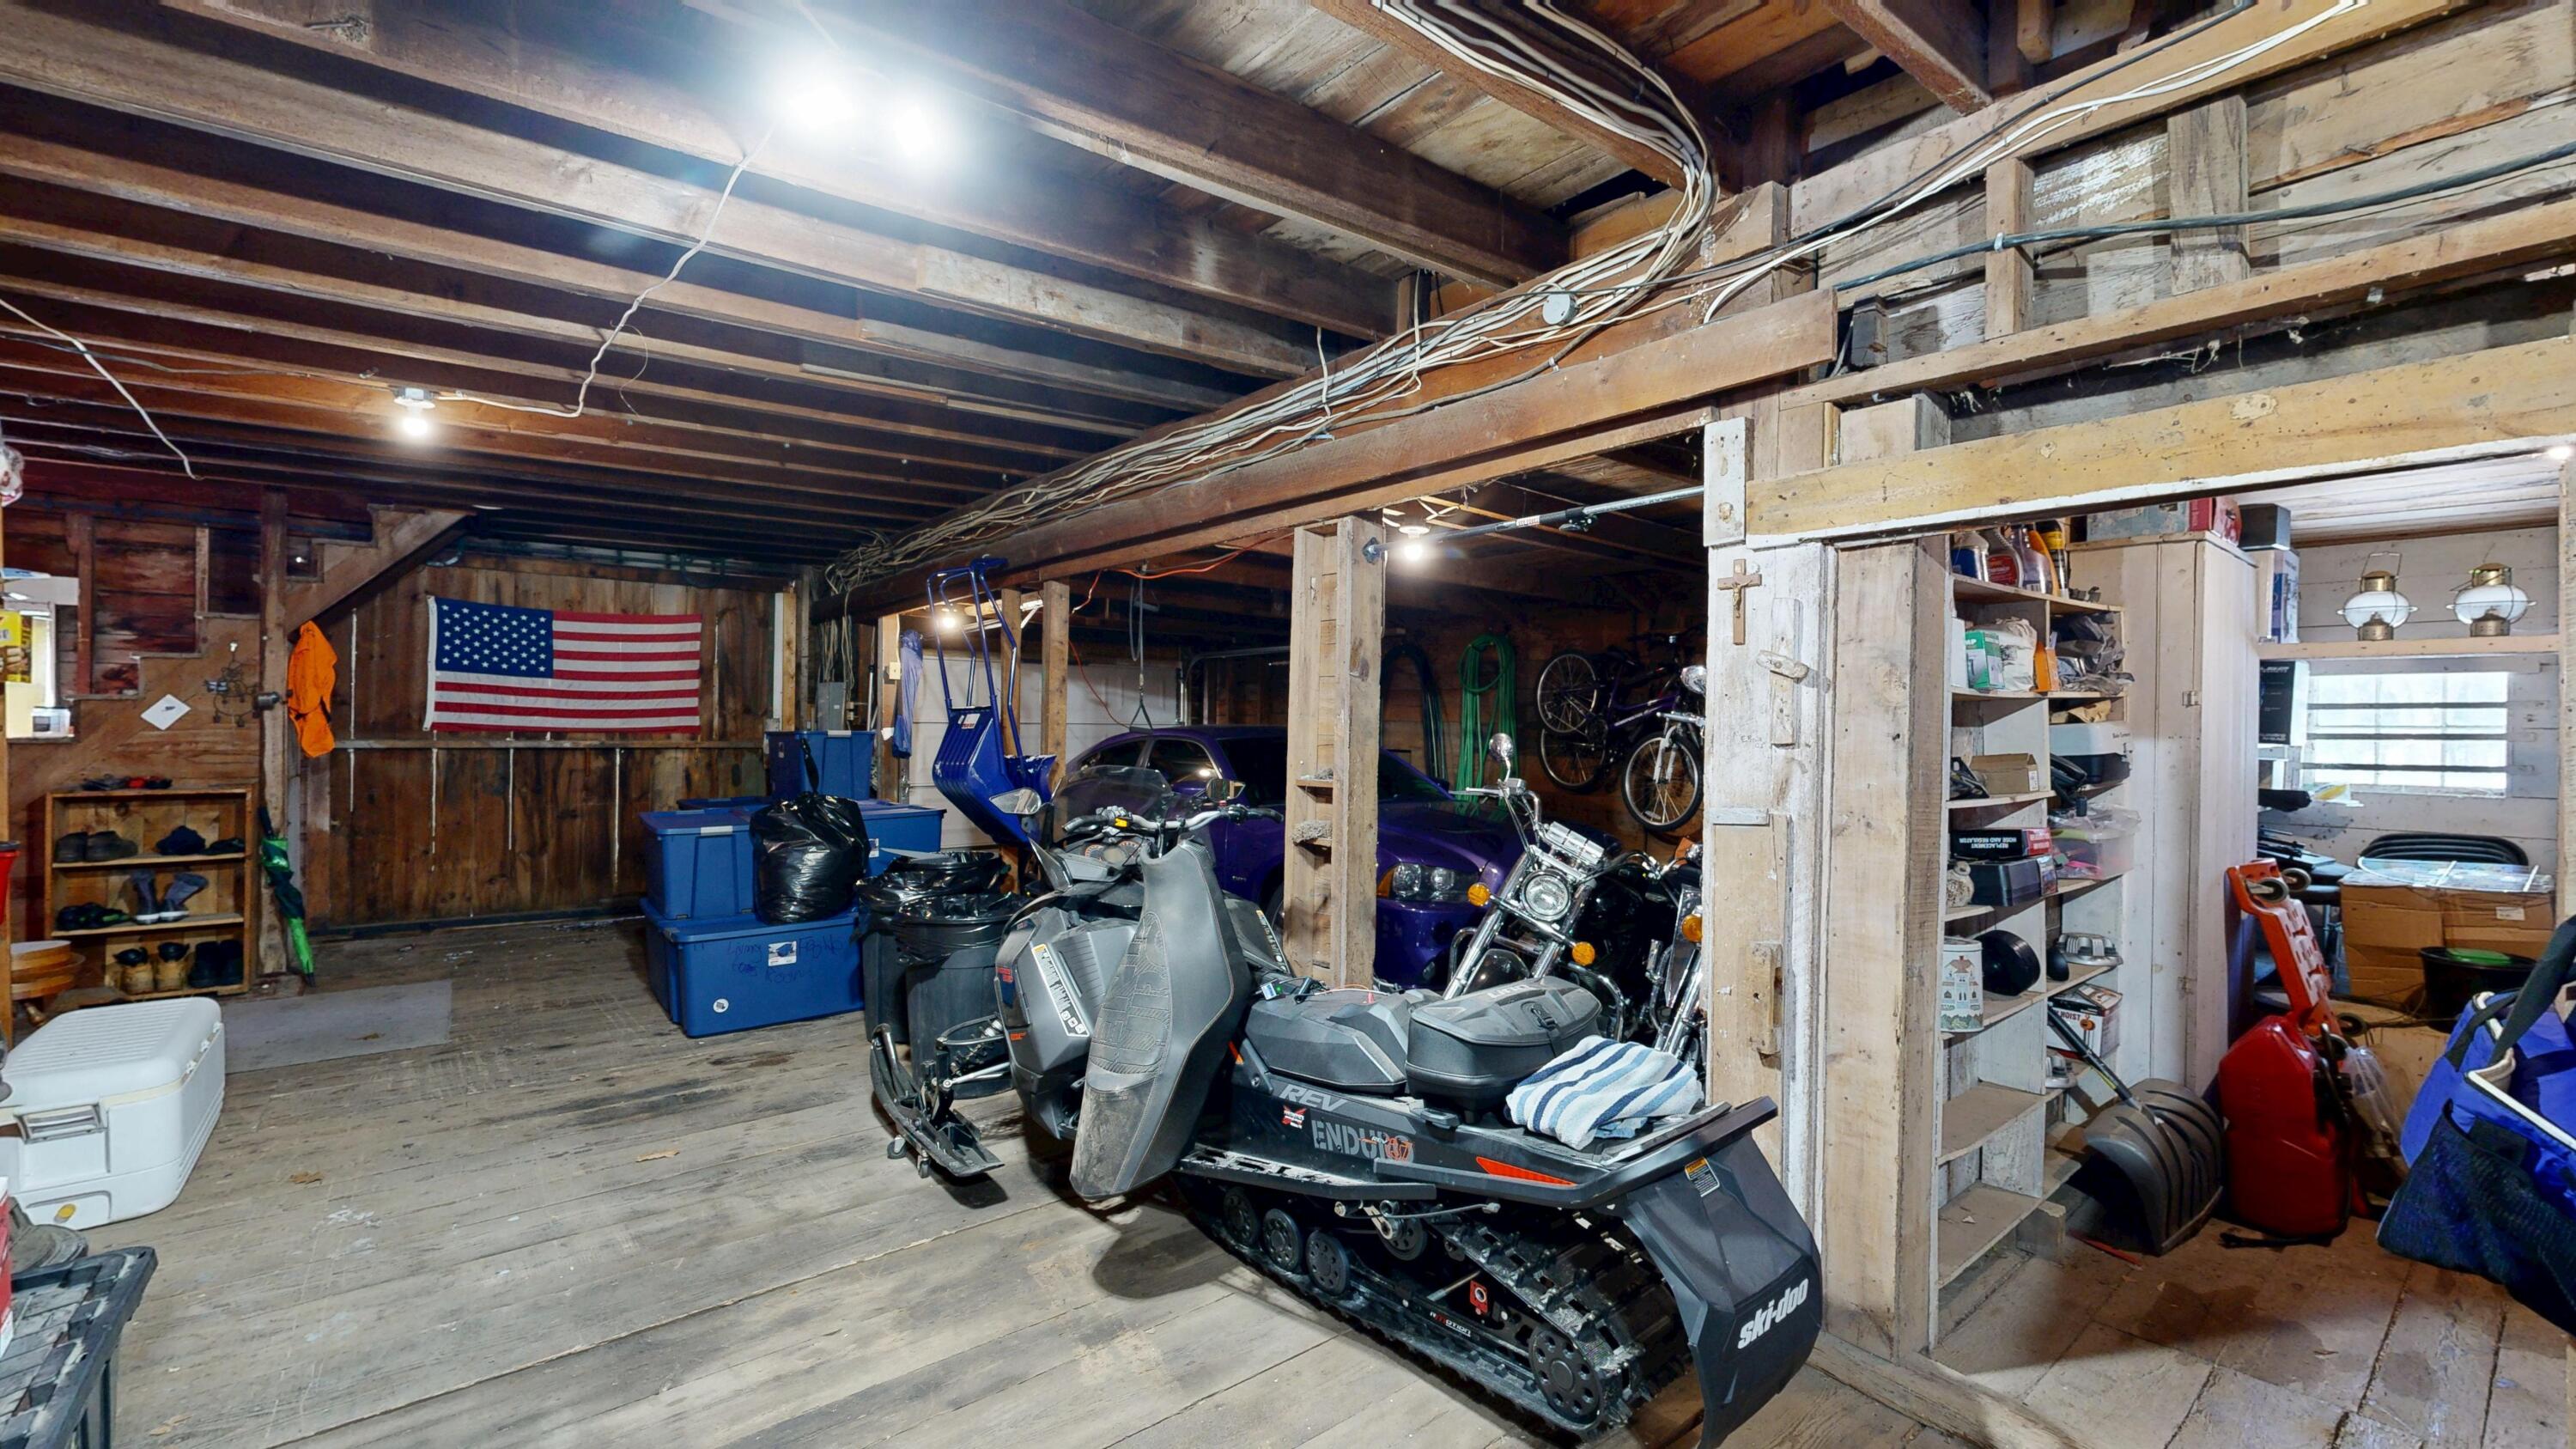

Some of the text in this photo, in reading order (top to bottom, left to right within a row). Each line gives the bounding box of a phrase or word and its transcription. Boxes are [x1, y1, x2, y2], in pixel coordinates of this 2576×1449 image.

[2060, 1010, 2081, 1021] HOIST
[1279, 1084, 1349, 1111] REV
[1737, 1277, 1810, 1350] ski-doo
